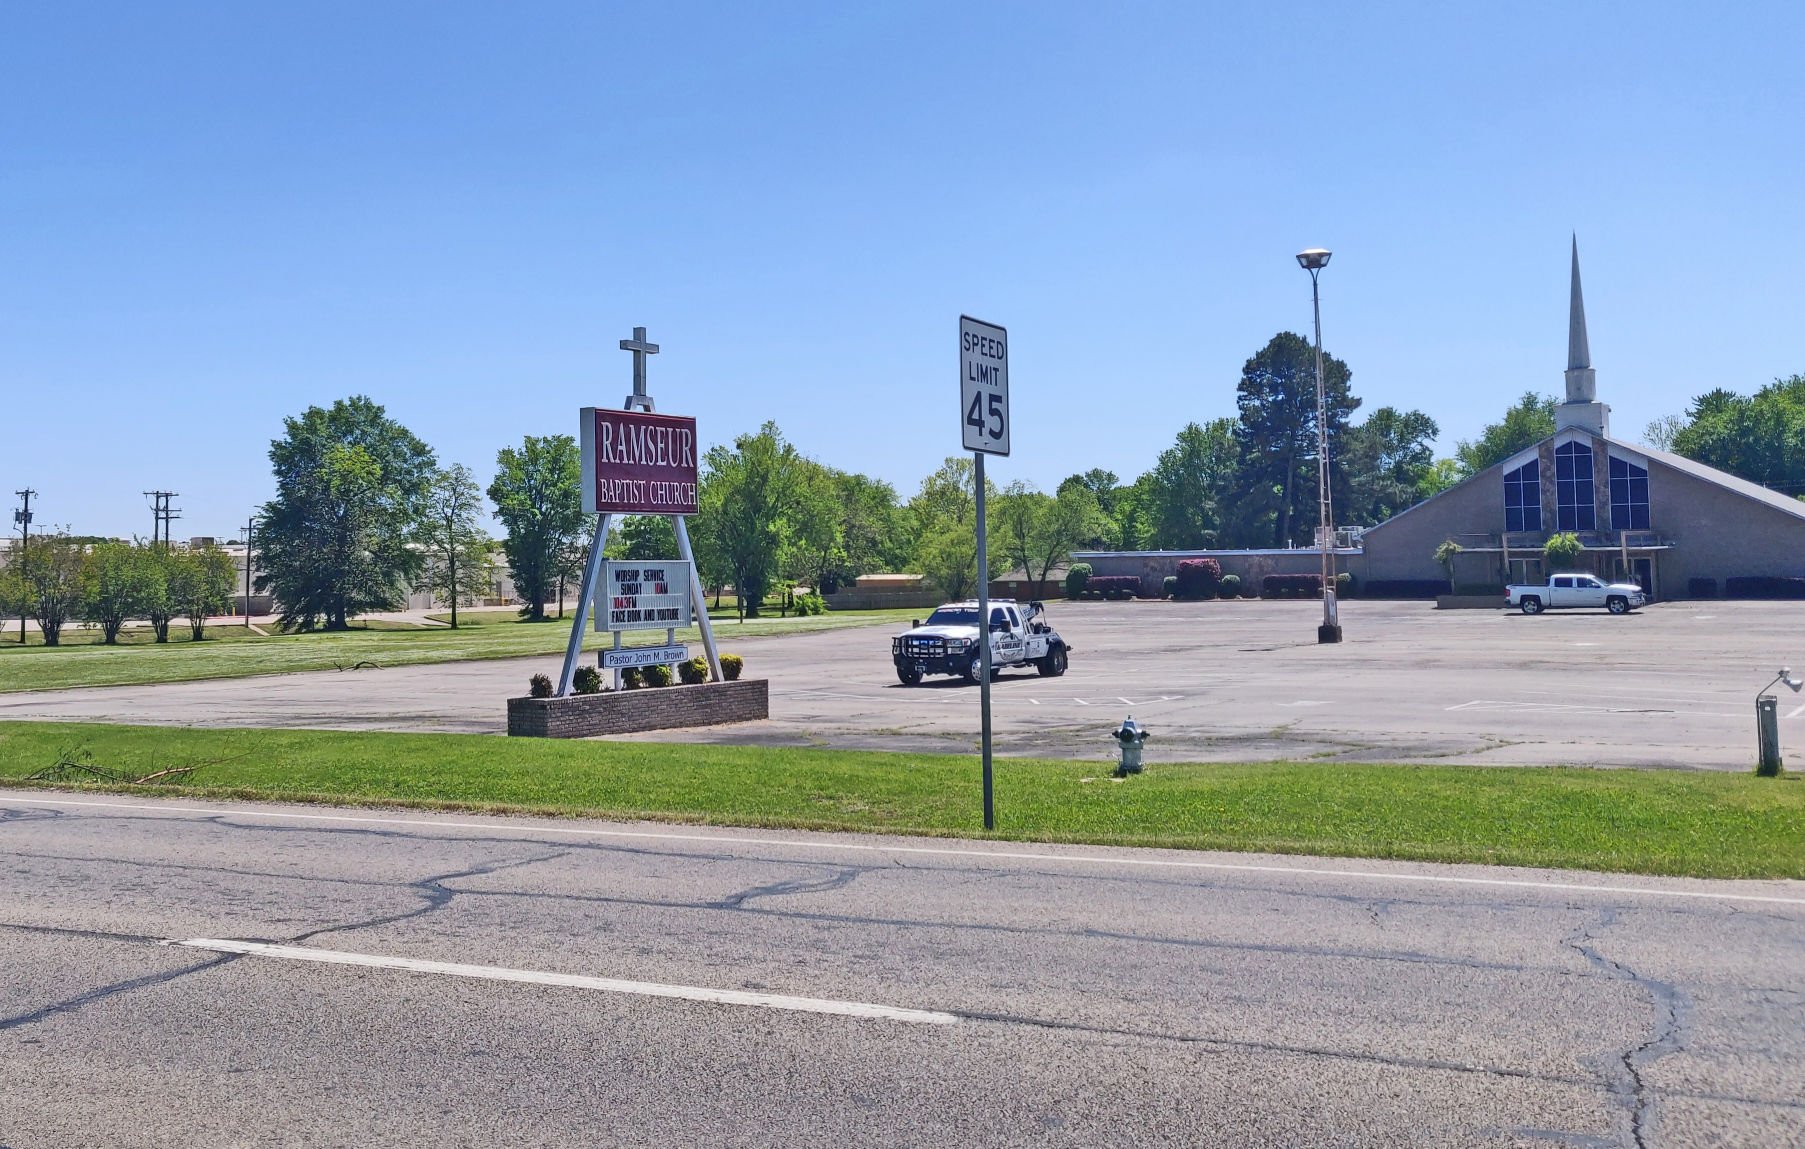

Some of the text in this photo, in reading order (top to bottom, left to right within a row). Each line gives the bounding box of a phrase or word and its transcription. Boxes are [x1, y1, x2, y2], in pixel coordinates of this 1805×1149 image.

[963, 331, 1005, 360] SPEED
[969, 361, 1000, 386] LIMIT
[967, 390, 1004, 440] 45
[600, 421, 695, 468] RAMSEUR
[599, 479, 697, 505] BAPTIST CHURCH
[614, 569, 665, 582] WORSHIP SERVICE
[620, 583, 642, 595] SUNDAY
[611, 608, 679, 623] FACE BOOK AND YOUTUBE
[609, 650, 684, 665] Pastor John M. Brown
